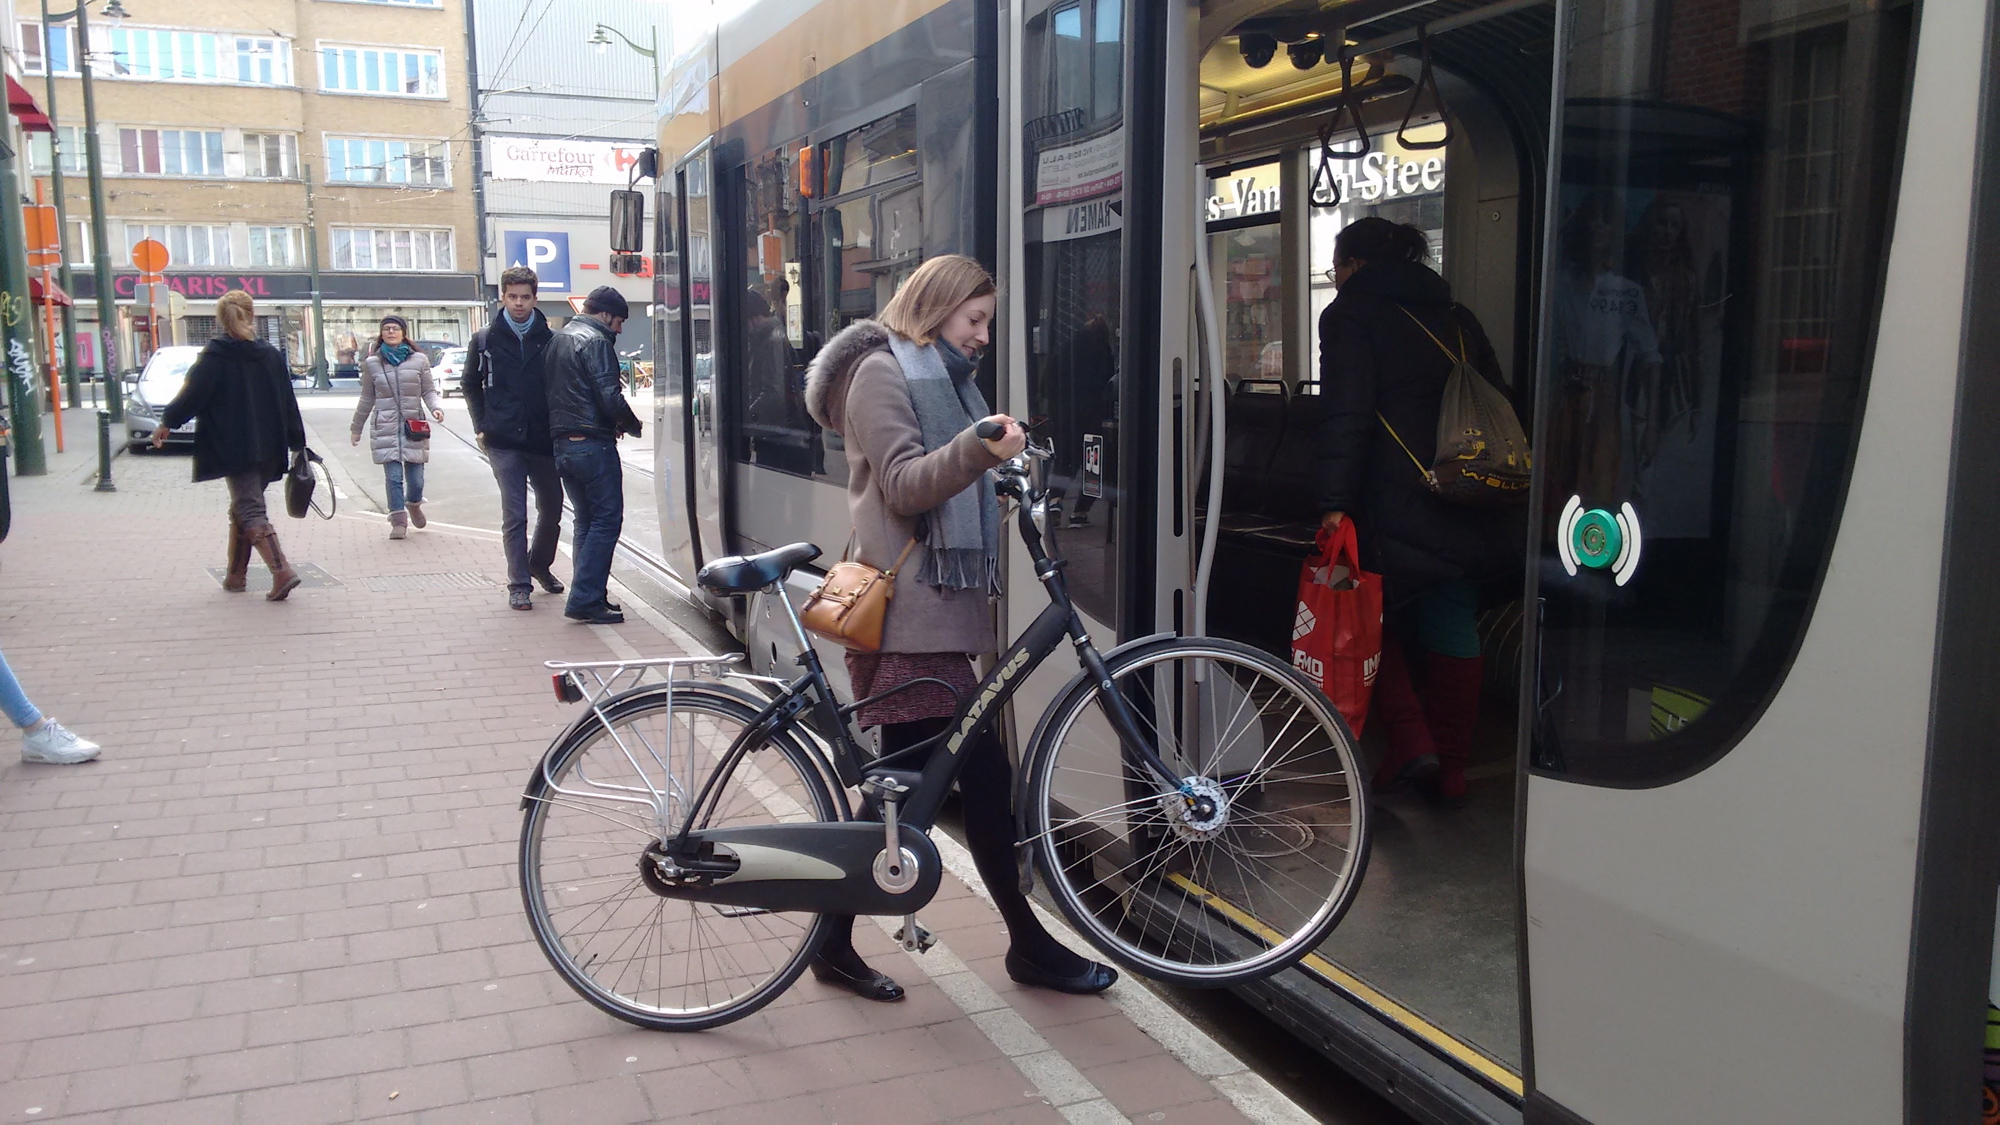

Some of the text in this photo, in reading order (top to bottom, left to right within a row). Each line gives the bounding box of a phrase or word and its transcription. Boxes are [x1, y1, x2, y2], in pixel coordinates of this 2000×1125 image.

[507, 145, 595, 164] Carrefour
[547, 164, 594, 176] market
[1229, 177, 1281, 215] Van
[1312, 173, 1350, 203] en
[1362, 152, 1443, 200] Stee
[526, 238, 557, 278] P
[237, 276, 271, 295] XL
[947, 647, 1030, 755] BATAVUS
